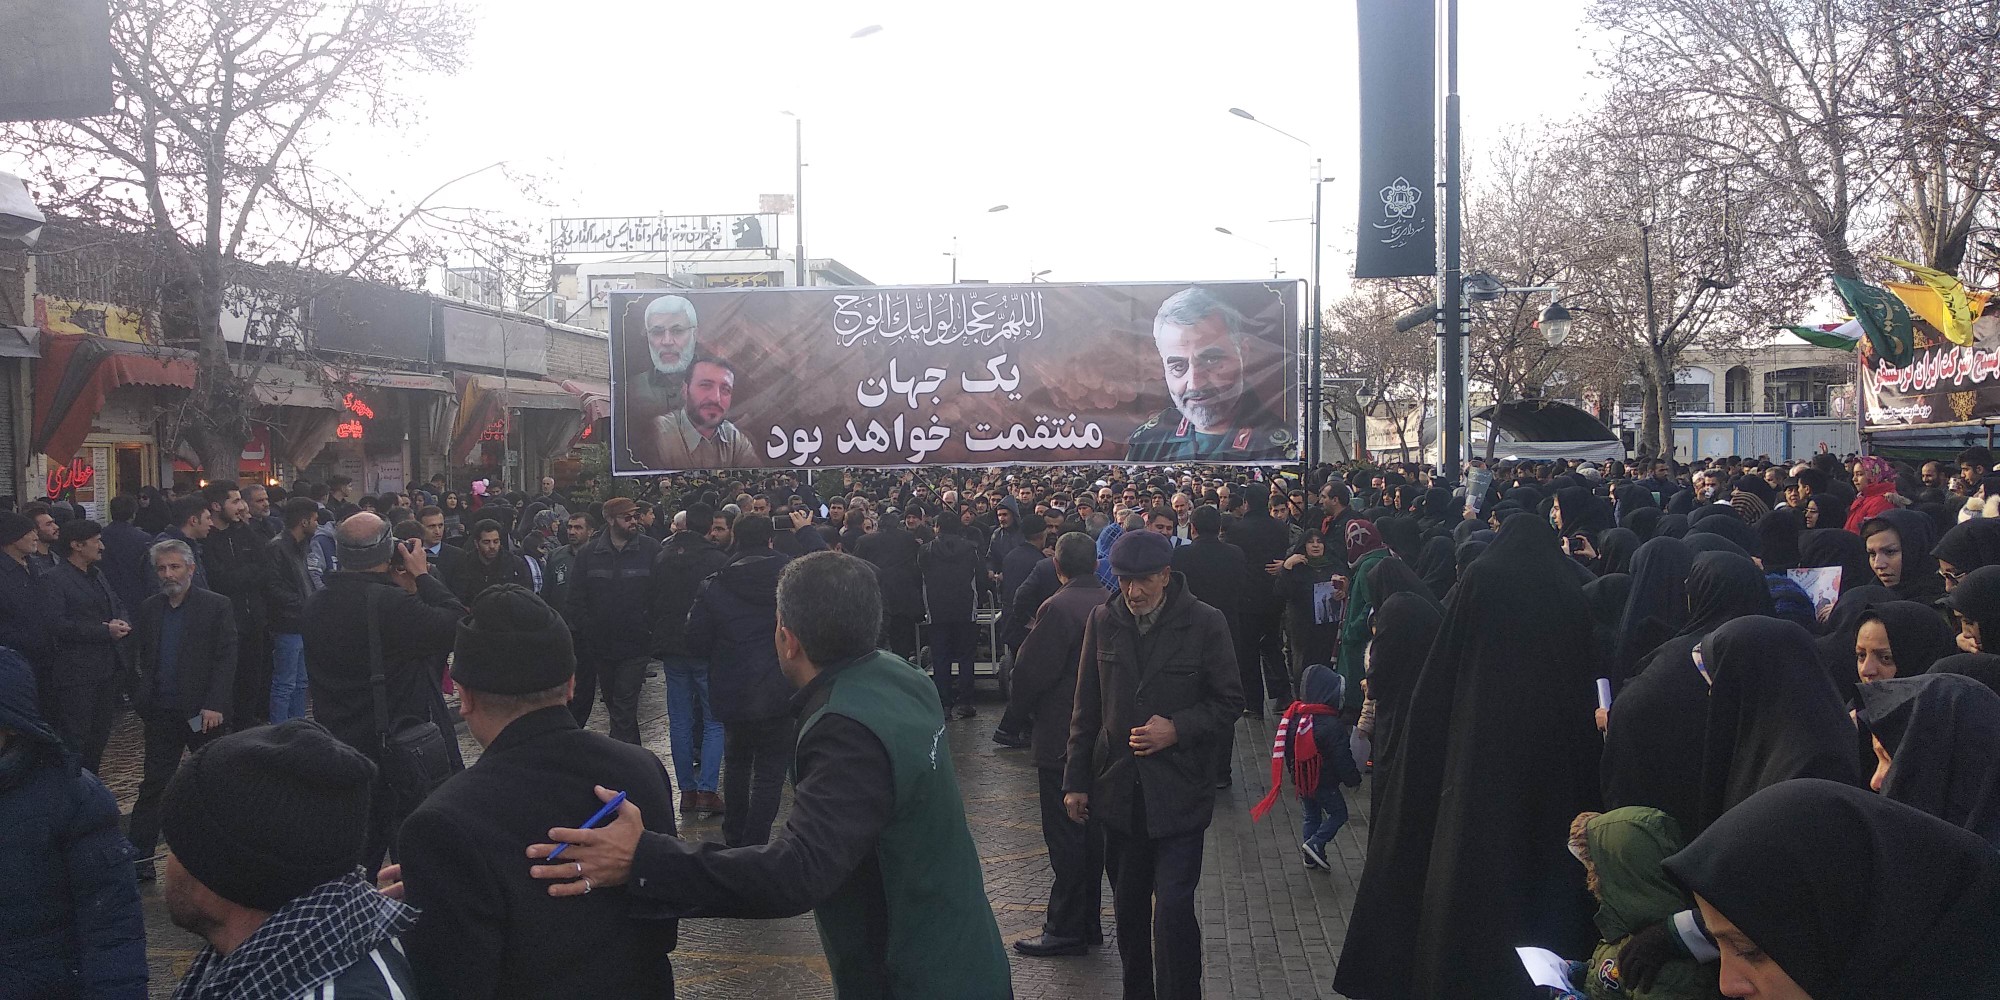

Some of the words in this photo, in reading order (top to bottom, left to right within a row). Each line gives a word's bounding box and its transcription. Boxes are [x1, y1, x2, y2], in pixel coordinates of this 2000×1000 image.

[856, 357, 948, 409] جهان
[961, 354, 1022, 401] یک
[765, 420, 824, 466] بود
[836, 412, 951, 464] خواهد
[965, 412, 1104, 453] منتقمت
[46, 457, 94, 500] عطاری
